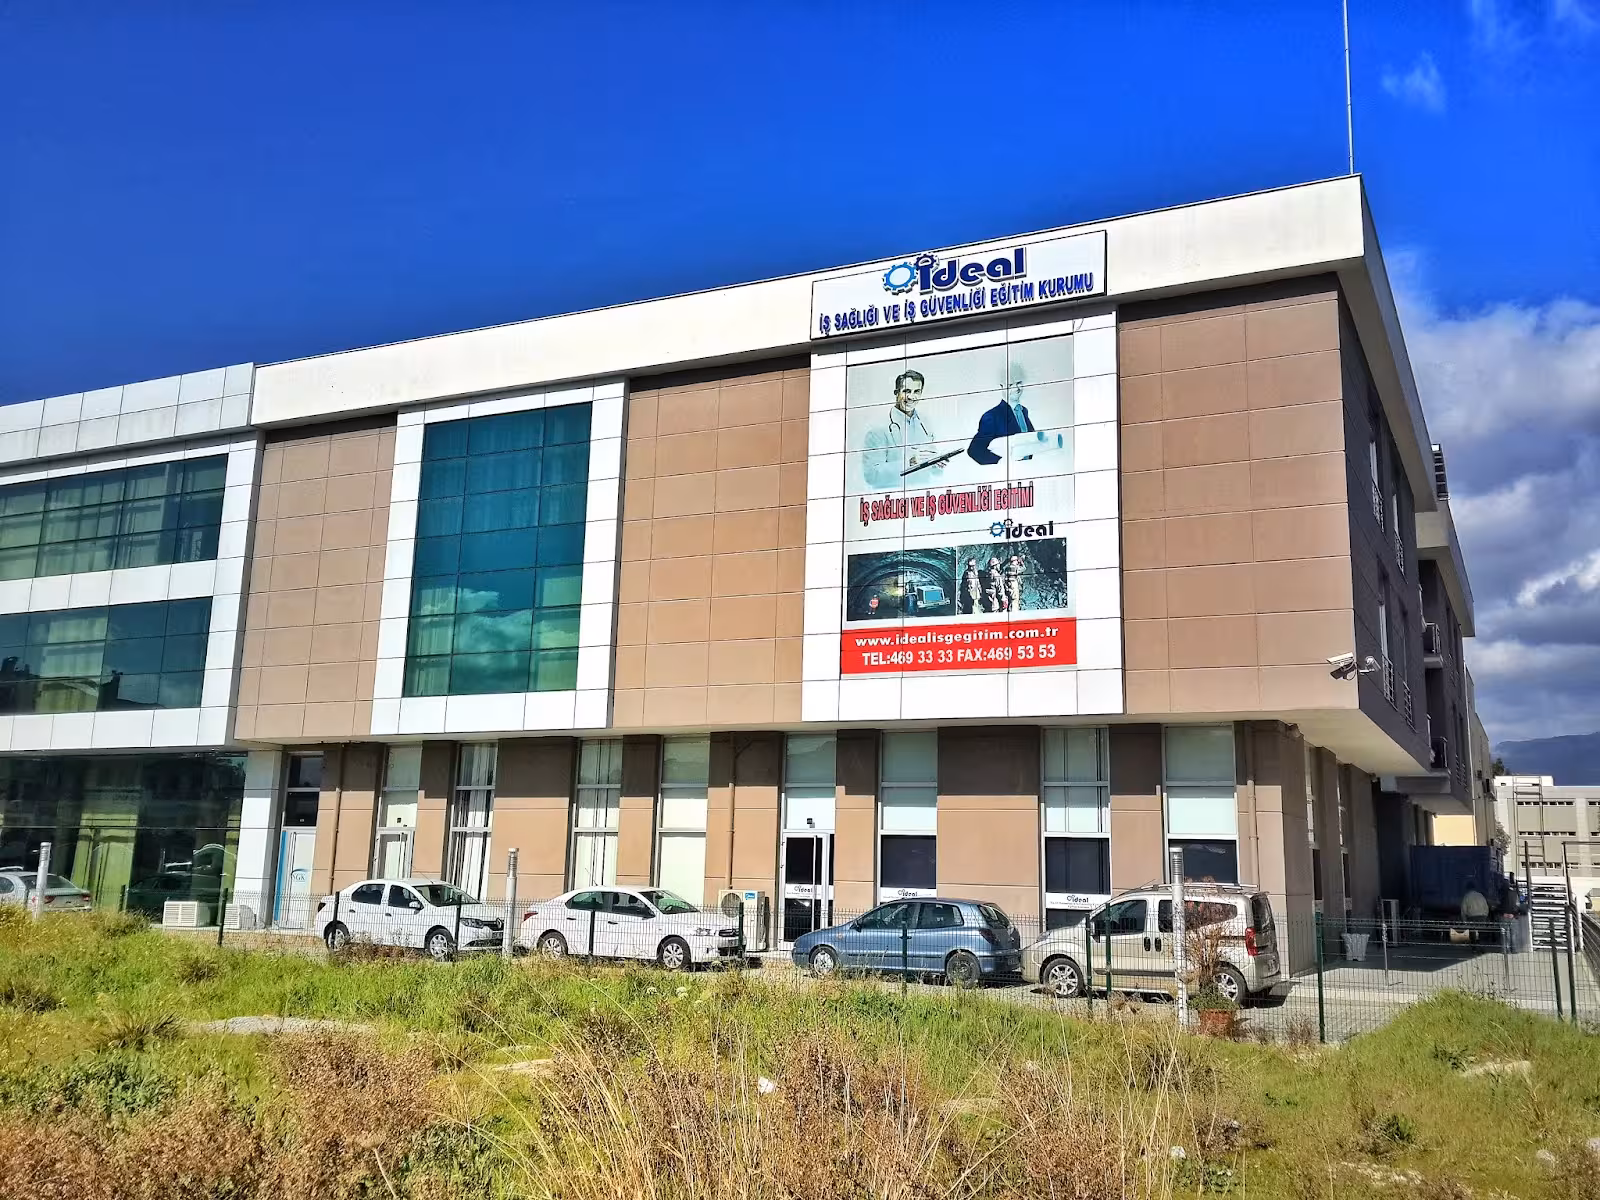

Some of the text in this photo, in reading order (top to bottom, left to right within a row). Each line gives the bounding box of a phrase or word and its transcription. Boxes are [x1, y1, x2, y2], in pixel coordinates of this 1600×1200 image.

[918, 247, 1026, 293] ideal
[819, 272, 1094, 337] İŞ SAĞLIĞI VE İŞ GÜVENLİĞİ EĞİTİM KURUMU
[860, 497, 870, 527] İŞ
[910, 496, 925, 517] VE
[926, 491, 937, 521] İŞ
[938, 485, 992, 515] GÜVENLİĞİ
[1005, 519, 1054, 539] ideal
[855, 627, 1059, 647] www.idealisgegitim.com.tr
[862, 643, 1056, 666] TEL:469 33 33 FAX:469 53 53
